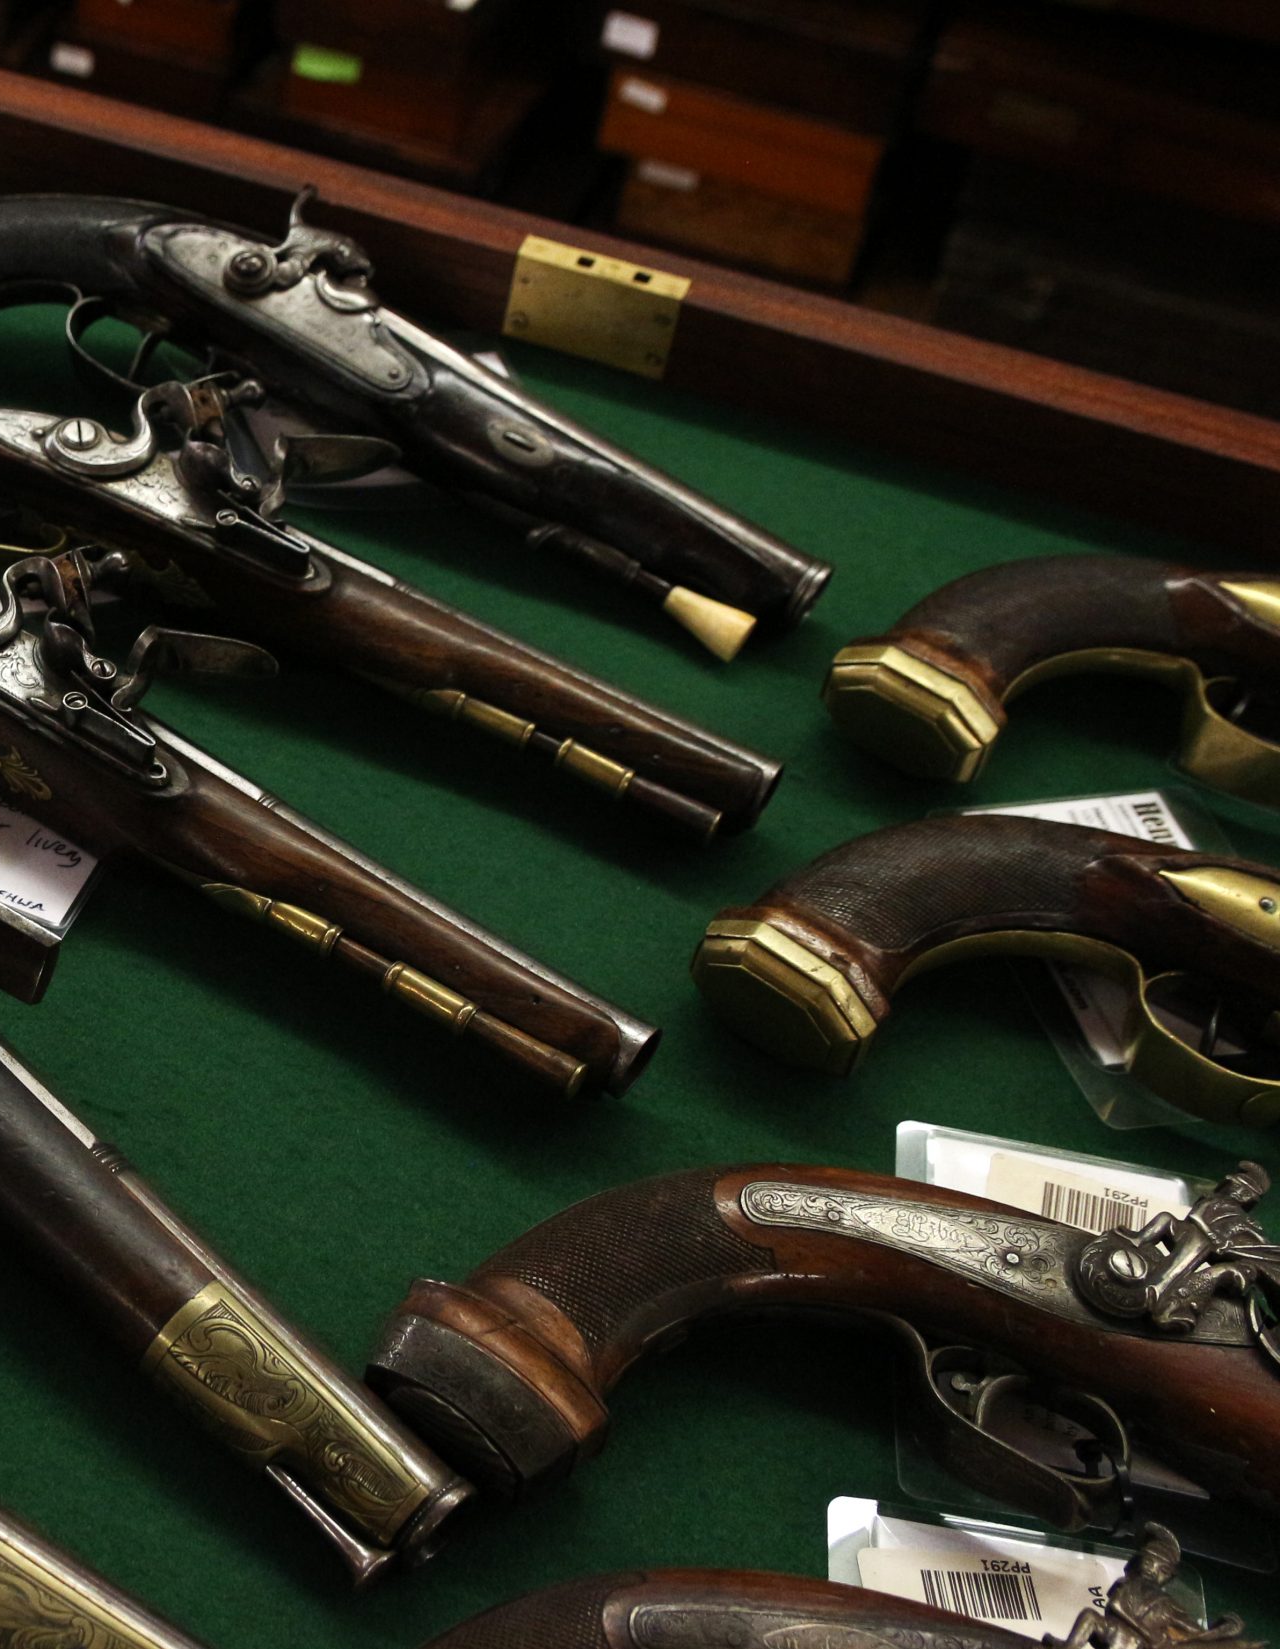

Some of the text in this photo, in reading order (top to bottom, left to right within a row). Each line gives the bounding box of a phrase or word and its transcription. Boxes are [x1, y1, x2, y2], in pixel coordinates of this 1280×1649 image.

[26, 828, 81, 867] livery
[1104, 1187, 1149, 1208] PP291
[980, 1559, 1031, 1574] PP291
